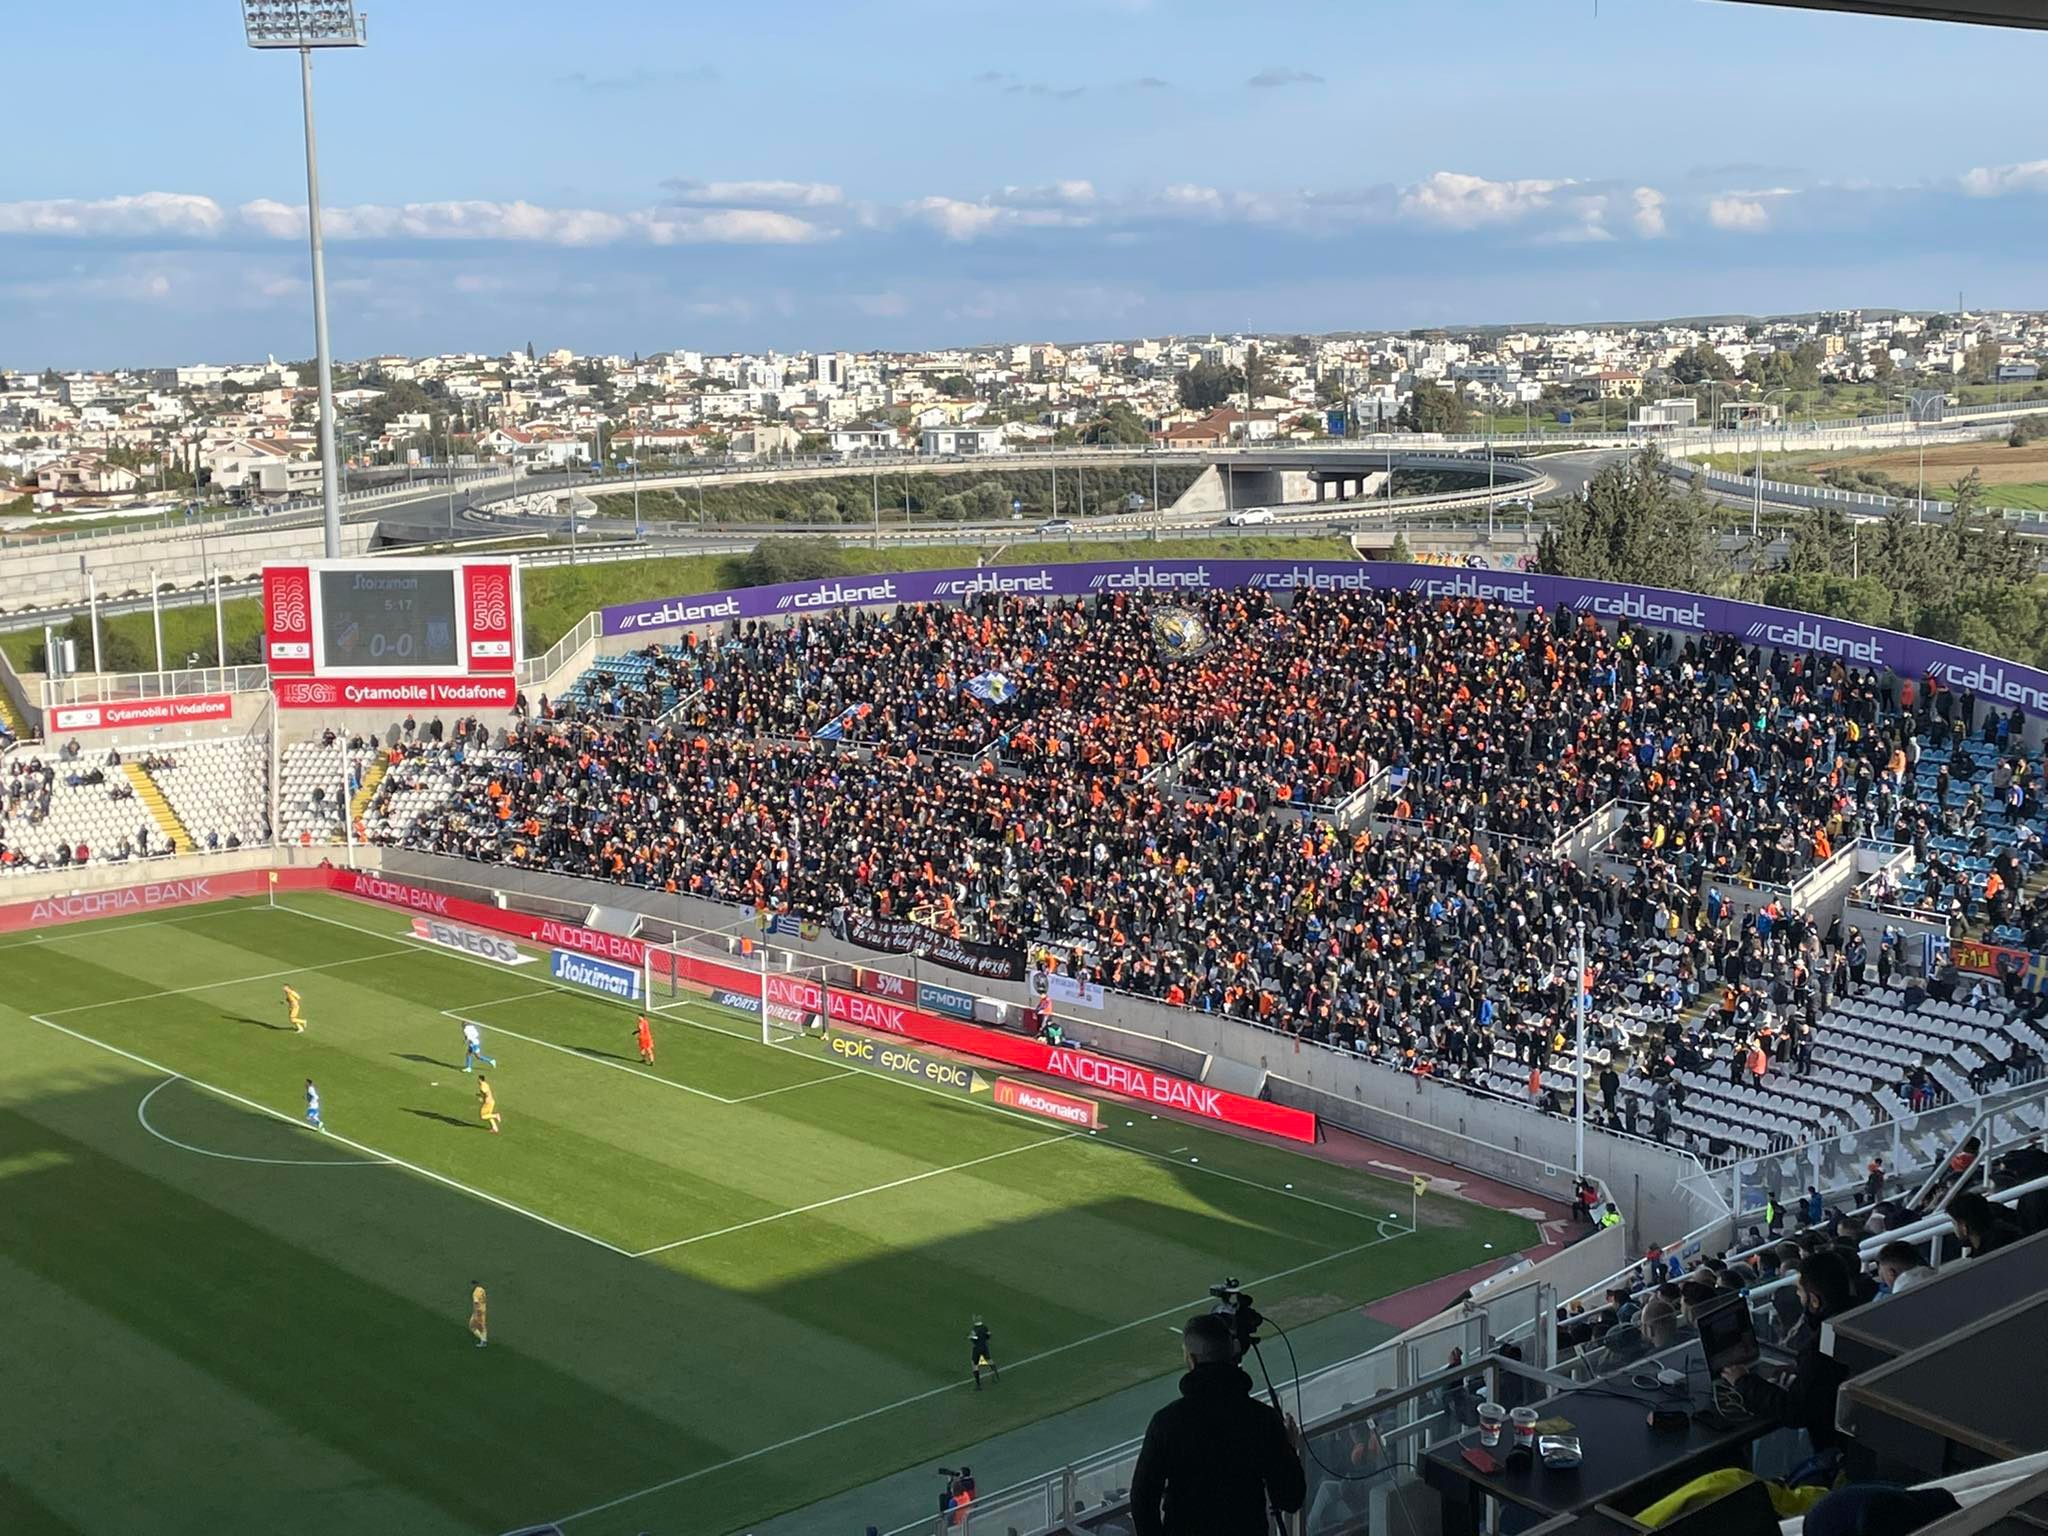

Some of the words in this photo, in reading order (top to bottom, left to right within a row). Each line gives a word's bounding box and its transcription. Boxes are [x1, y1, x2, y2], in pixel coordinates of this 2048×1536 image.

[950, 570, 1053, 594] cablenet
[1108, 565, 1210, 587] cablenet
[794, 579, 896, 607] cablenet
[637, 596, 740, 626] cablenet
[1594, 592, 1705, 628] cablenet
[1767, 621, 1883, 665] cablenet
[344, 684, 427, 703] Cytamobile
[438, 685, 506, 700] Vodafone
[106, 707, 169, 722] Cytamobile
[175, 701, 225, 715] Vodafone
[31, 889, 140, 921] ANCORIA
[144, 878, 211, 904] BANK
[354, 875, 410, 905] ANCORIA
[411, 889, 453, 914] BANK
[432, 922, 518, 961] ENEOS
[541, 921, 607, 955] ANCORIA
[555, 954, 629, 996] Stoiximan
[876, 974, 904, 995] SYM
[722, 993, 759, 1011] SPORTS
[920, 988, 973, 1010] CFMOTO
[850, 999, 904, 1032] BANK
[832, 1038, 874, 1060] epic
[880, 1050, 921, 1074] epic
[925, 1062, 967, 1086] epic
[1047, 1051, 1148, 1097] ANCORIA
[1151, 1076, 1222, 1117] BANK
[1018, 1092, 1088, 1123] McDonald's
